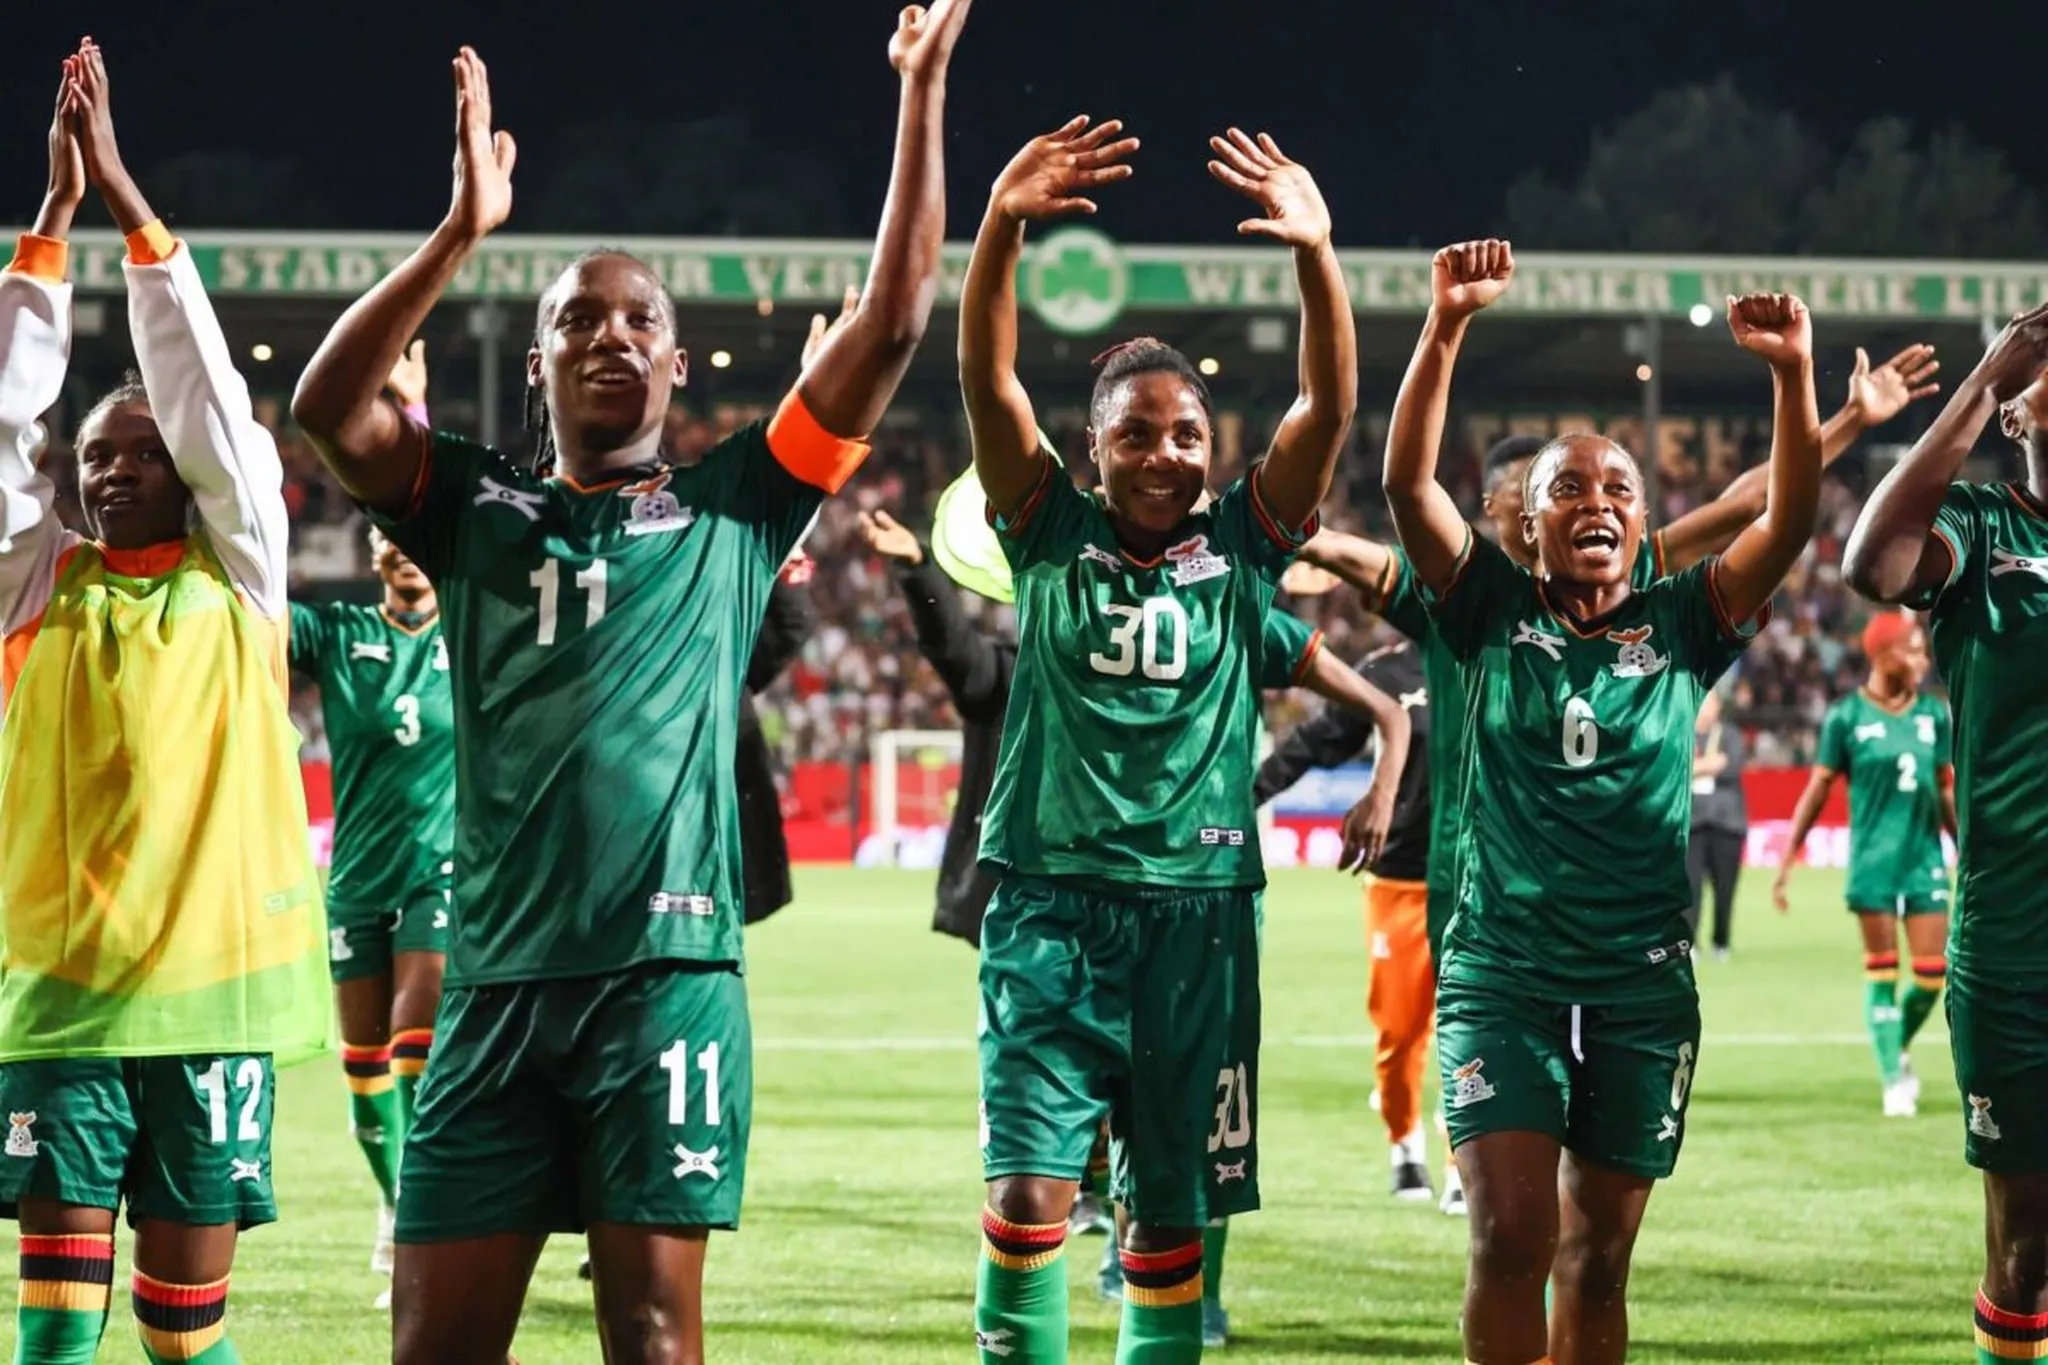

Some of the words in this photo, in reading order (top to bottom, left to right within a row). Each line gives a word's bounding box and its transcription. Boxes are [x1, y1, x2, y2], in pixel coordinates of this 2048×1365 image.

[530, 559, 608, 646] 11
[1090, 596, 1188, 681] 30
[393, 694, 421, 747] 3
[1562, 696, 1599, 768] 6
[1897, 752, 1918, 792] 2
[196, 1058, 264, 1144] 12
[659, 1039, 721, 1126] 11
[1207, 1060, 1251, 1154] 30
